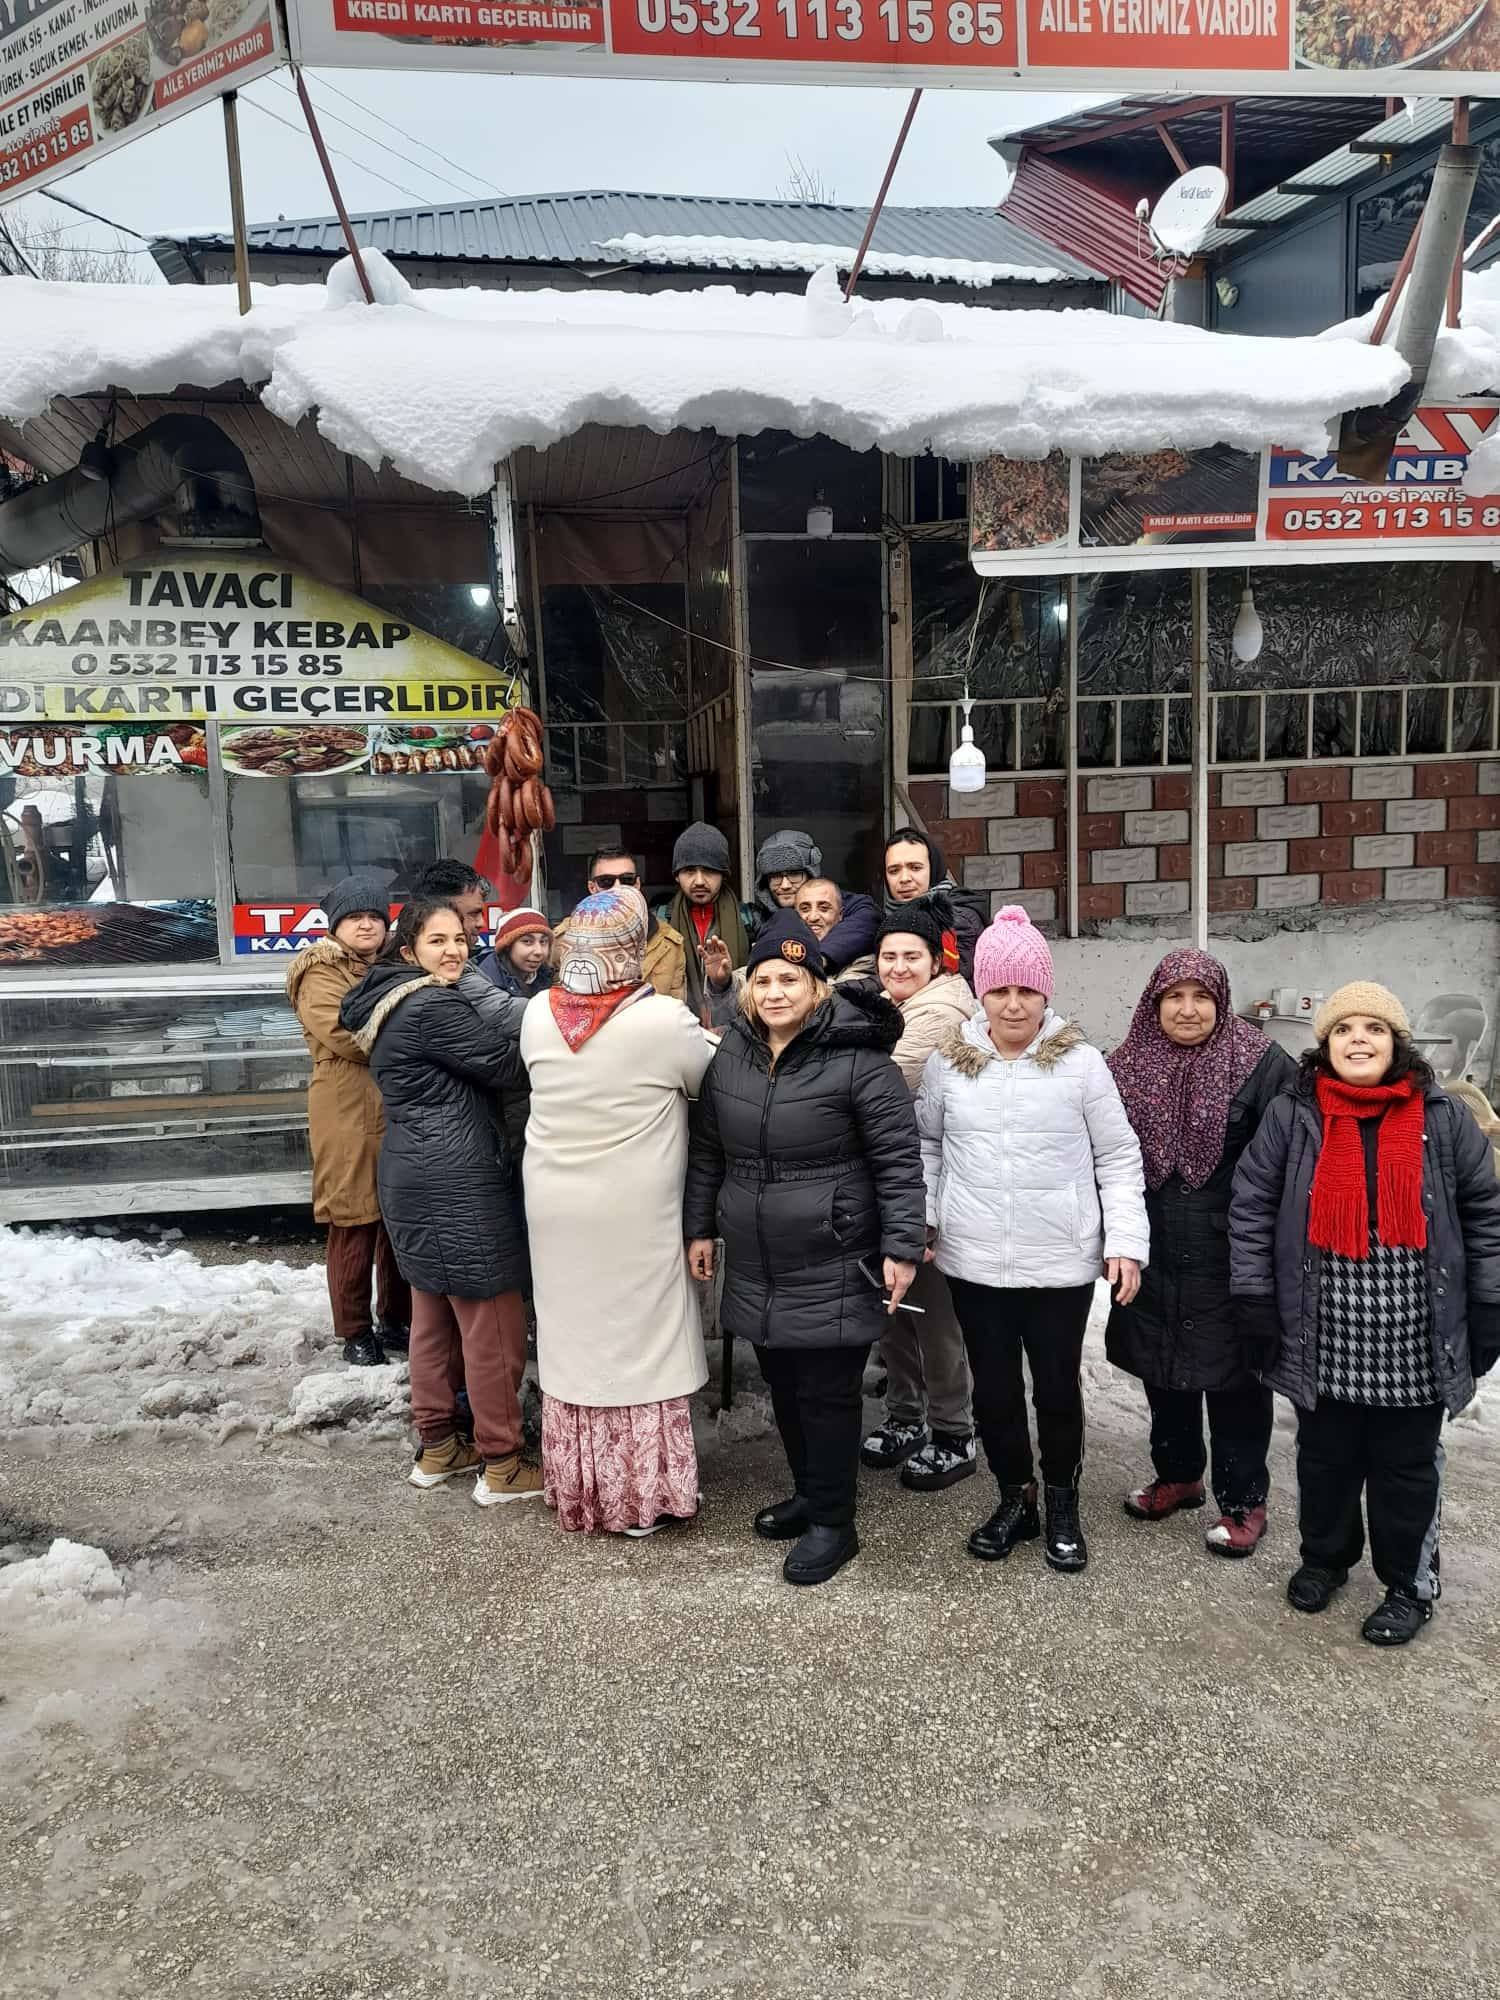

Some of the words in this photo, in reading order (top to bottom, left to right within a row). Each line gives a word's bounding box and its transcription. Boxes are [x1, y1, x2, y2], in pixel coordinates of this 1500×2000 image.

[348, 0, 408, 21] KREDİ
[415, 3, 472, 24] KARTI
[478, 7, 592, 31] GEÇERLİDİR
[637, 0, 762, 37] 0532
[776, 0, 863, 40] 113
[879, 0, 934, 43] 15
[948, 1, 1004, 45] 85
[1196, 0, 1277, 36] VARDIR
[2, 40, 29, 64] TAVUK
[48, 5, 77, 36] KANAT
[30, 50, 58, 79] SUCUK
[58, 30, 88, 62] EKMEK
[94, 1, 139, 40] KAVURMA
[163, 74, 185, 98] AİLE
[184, 50, 225, 86] YERİMİZ
[225, 32, 265, 64] VARDIR
[17, 104, 30, 127] ET
[33, 73, 86, 118] PİŞİRİLİR
[5, 136, 24, 156] ALO
[24, 115, 61, 145] SİPARİŞ
[22, 142, 49, 171] 113
[51, 131, 69, 156] 15
[70, 119, 89, 146] 85
[1341, 490, 1382, 504] ALO
[1384, 487, 1467, 505] SİPARİŞ
[1176, 515, 1201, 526] KARTI
[1283, 508, 1362, 531] 0532
[1373, 507, 1430, 529] 113
[1440, 507, 1474, 528] 15
[123, 570, 293, 608] TAVACI
[0, 619, 240, 649] KAANBEY
[254, 621, 411, 649] KEBAP
[72, 653, 98, 675] 0
[109, 653, 177, 675] 532
[188, 653, 241, 675] 113
[251, 654, 289, 675] 15
[298, 654, 343, 675] 85
[63, 685, 216, 713] KARTI
[233, 685, 513, 717] GEÇERLİDİR
[0, 735, 183, 766] VURMA
[1301, 997, 1311, 1010] 3
